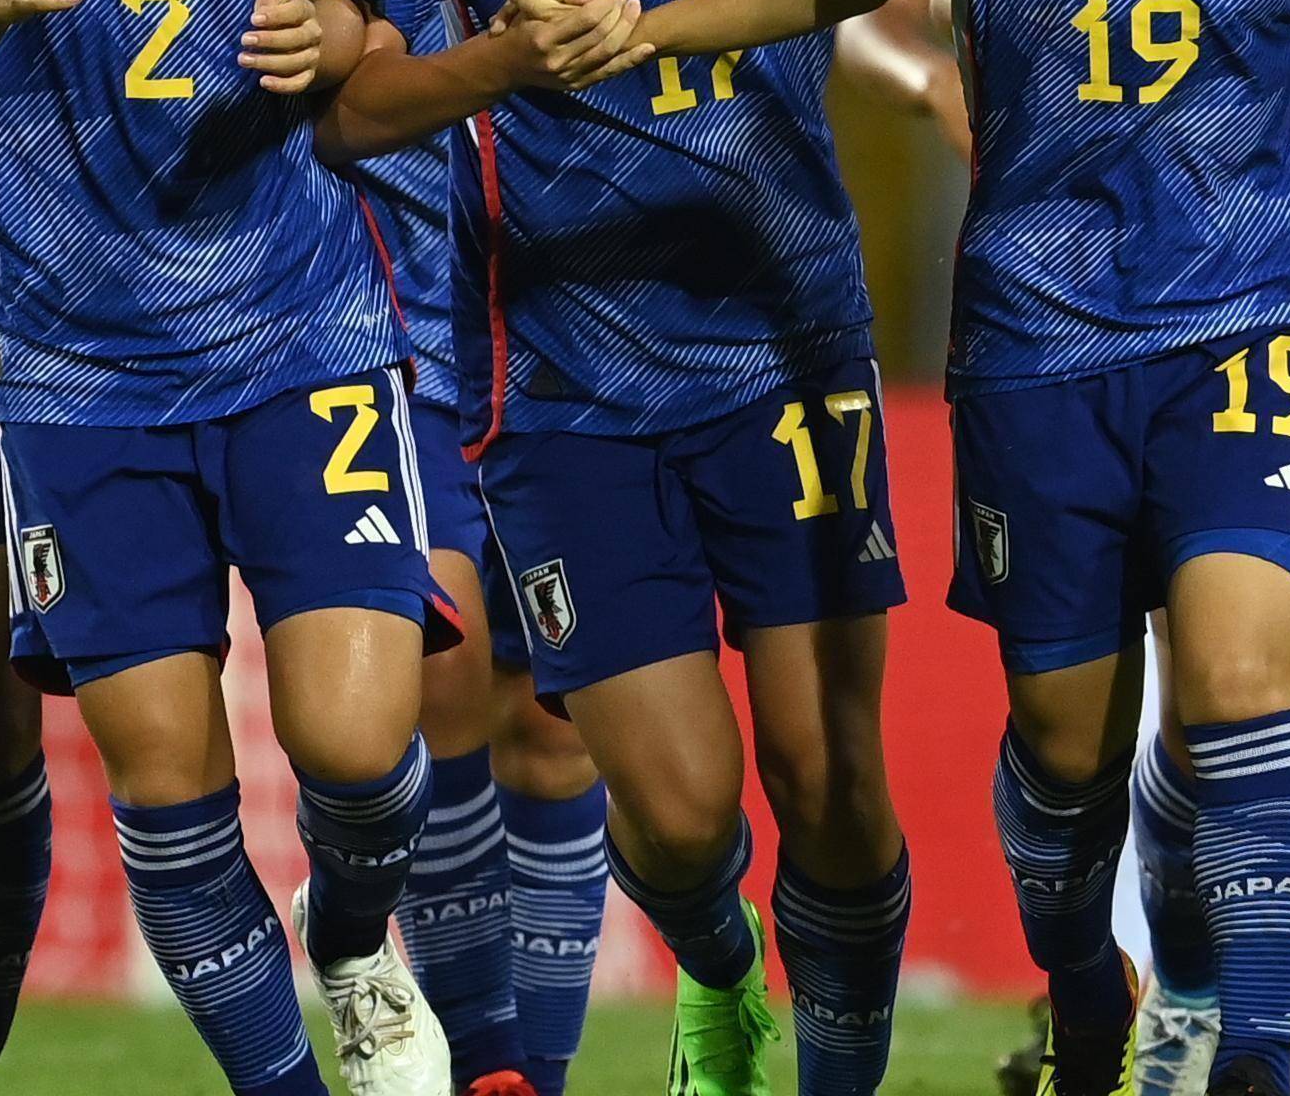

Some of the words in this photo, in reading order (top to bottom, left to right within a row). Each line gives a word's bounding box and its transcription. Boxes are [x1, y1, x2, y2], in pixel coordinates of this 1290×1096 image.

[309, 384, 389, 495] 2
[771, 390, 872, 521] 17
[511, 932, 601, 956] JAPA
[791, 984, 890, 1025] APAN
